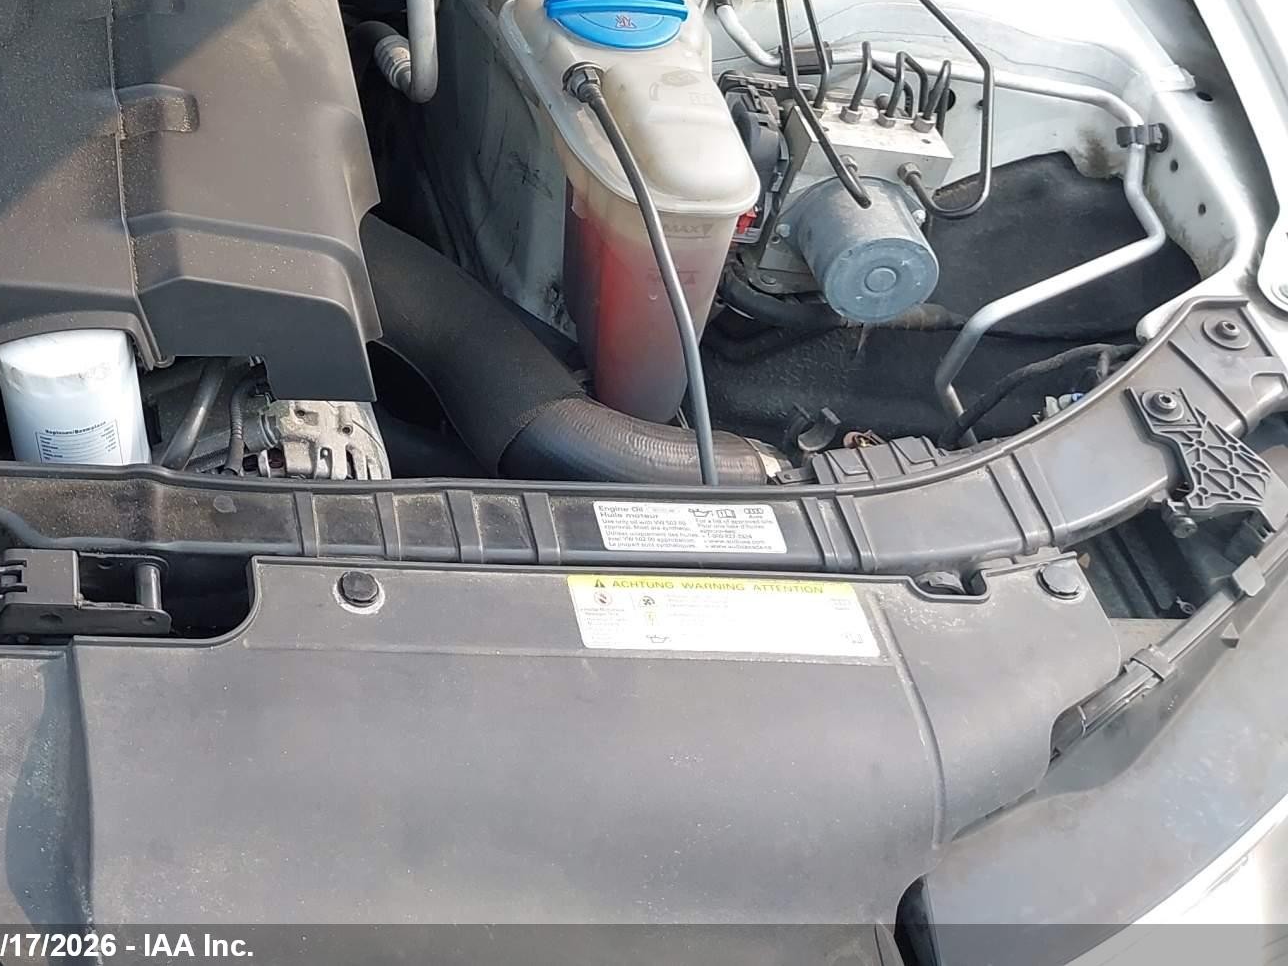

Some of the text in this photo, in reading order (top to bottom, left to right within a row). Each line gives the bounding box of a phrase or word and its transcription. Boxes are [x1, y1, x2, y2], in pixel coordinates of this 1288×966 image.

[598, 505, 629, 513] Engine
[612, 579, 824, 594] ACHTUNG WARNING ATTENTION
